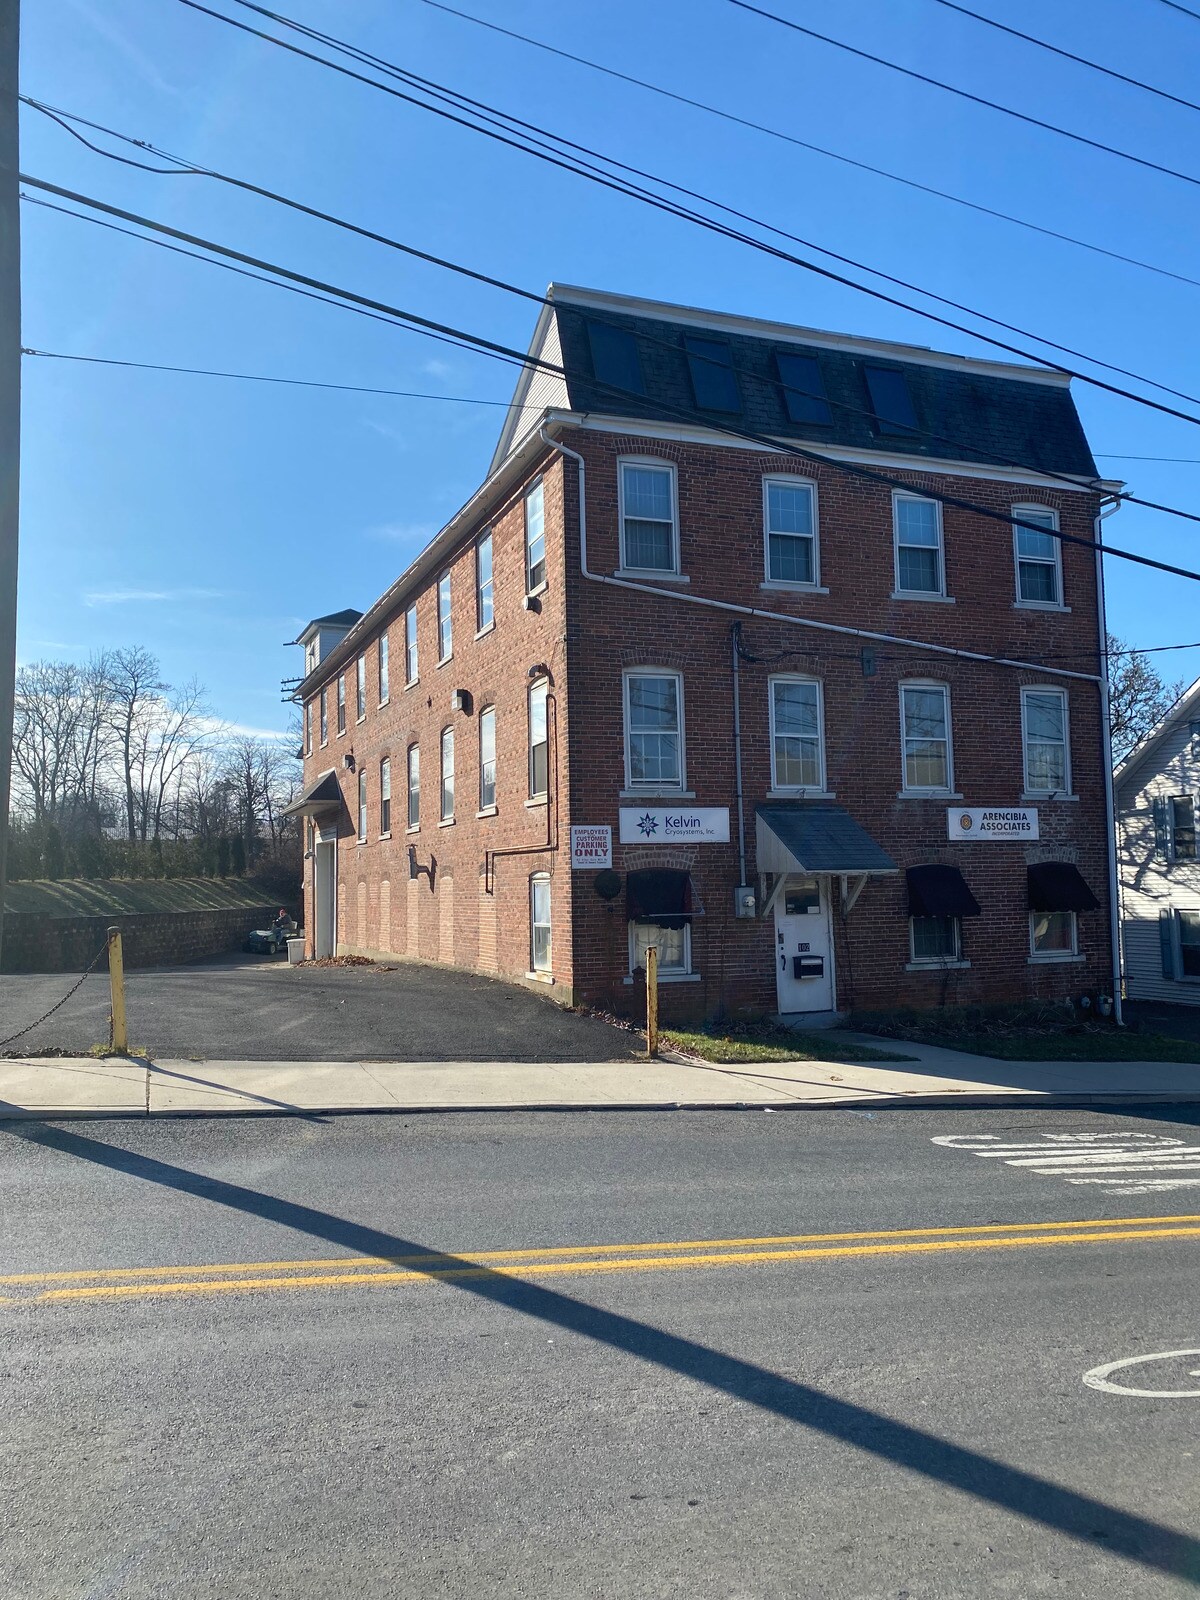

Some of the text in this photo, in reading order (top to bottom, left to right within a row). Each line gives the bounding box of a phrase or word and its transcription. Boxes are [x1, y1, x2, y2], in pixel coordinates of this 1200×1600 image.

[982, 812, 1028, 821] ARENCIBIA
[665, 815, 701, 828] Kelvin
[980, 822, 1031, 831] ASSOCIATES
[664, 828, 705, 836] Cryosystems,
[576, 841, 608, 849] PARKING
[574, 848, 609, 857] ONLY
[799, 944, 810, 952] 102
